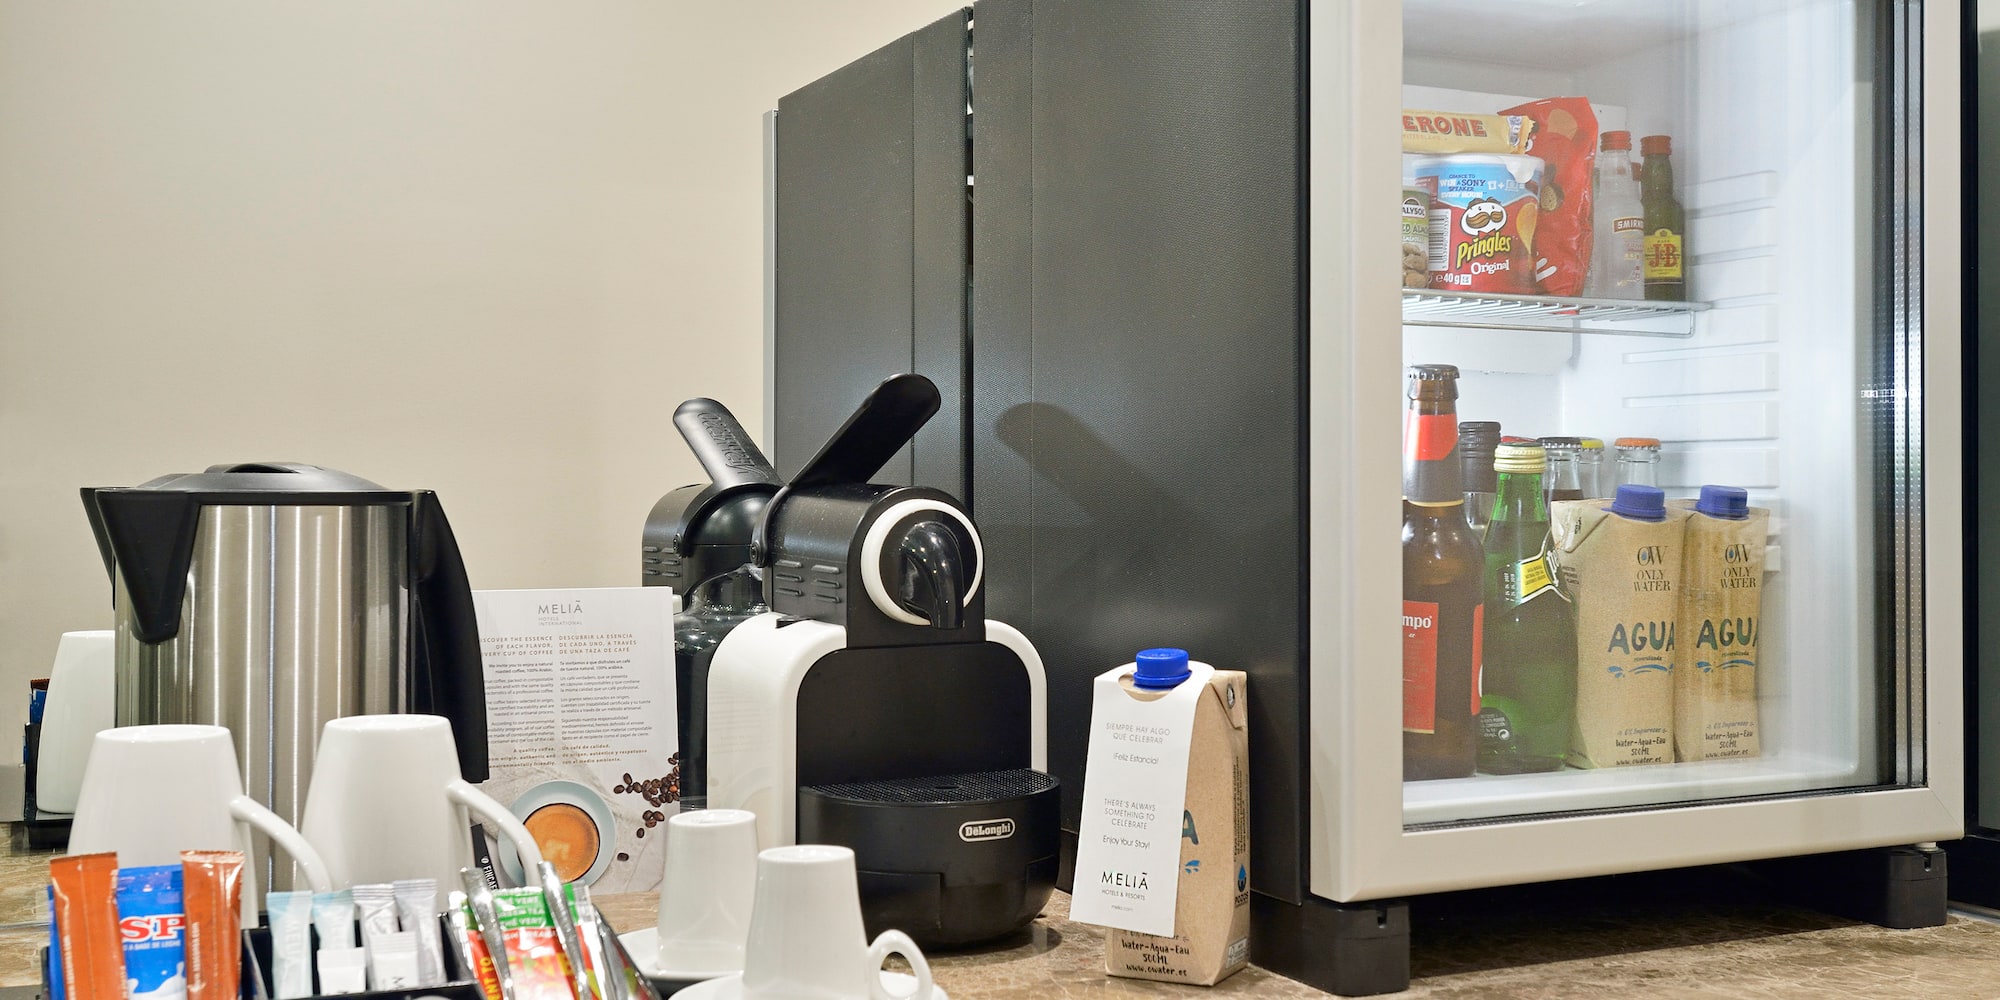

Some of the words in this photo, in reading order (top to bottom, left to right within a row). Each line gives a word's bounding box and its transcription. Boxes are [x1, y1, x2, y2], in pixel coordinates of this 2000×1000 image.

[1402, 116, 1487, 137] ERONE
[1456, 231, 1512, 270] Pringles
[1470, 260, 1510, 275] Original
[1637, 570, 1665, 580] ONLY
[1724, 567, 1752, 578] ONLY
[1634, 580, 1671, 592] WATER
[1720, 578, 1756, 589] WATER
[1608, 621, 1674, 655] AGUA
[1106, 722, 1134, 732] SIEMPRE
[1150, 727, 1171, 736] ALGO
[1113, 732, 1127, 741] QUE
[1129, 734, 1163, 744] CELEBRAR
[1104, 798, 1130, 809] THERE'S
[1131, 802, 1156, 812] ALWAYS
[1104, 807, 1144, 820] SOMETHING
[1111, 818, 1147, 830] CELEBRATE
[1102, 835, 1119, 844] Enjoy
[1120, 838, 1134, 847] Your
[1135, 839, 1150, 849] Stay!
[1125, 892, 1145, 900] RESORTS
